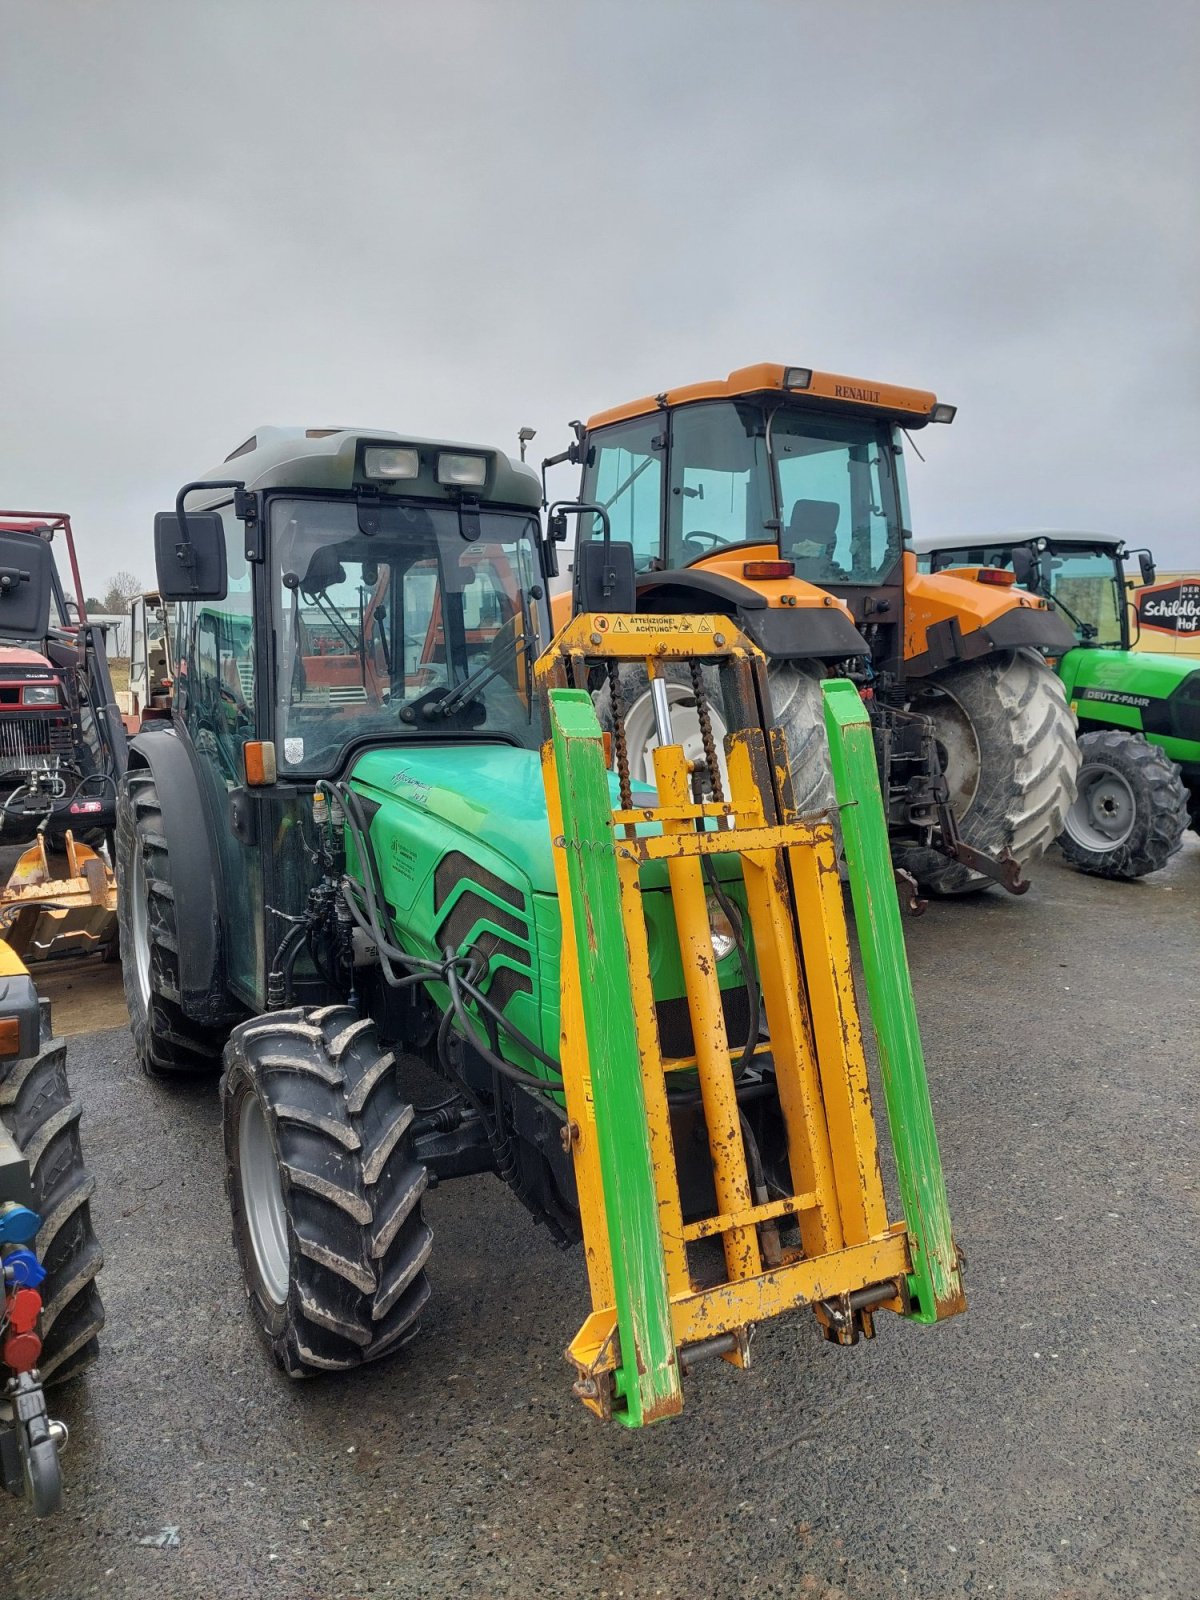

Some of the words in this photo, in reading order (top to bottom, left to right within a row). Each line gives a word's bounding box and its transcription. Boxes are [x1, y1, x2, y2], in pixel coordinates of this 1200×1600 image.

[835, 384, 880, 403] RENAULT
[1182, 585, 1200, 593] DER
[630, 616, 675, 624] ATTENZIONE!
[1177, 616, 1198, 631] Hof
[1087, 691, 1150, 707] DEUTZ-FAHR
